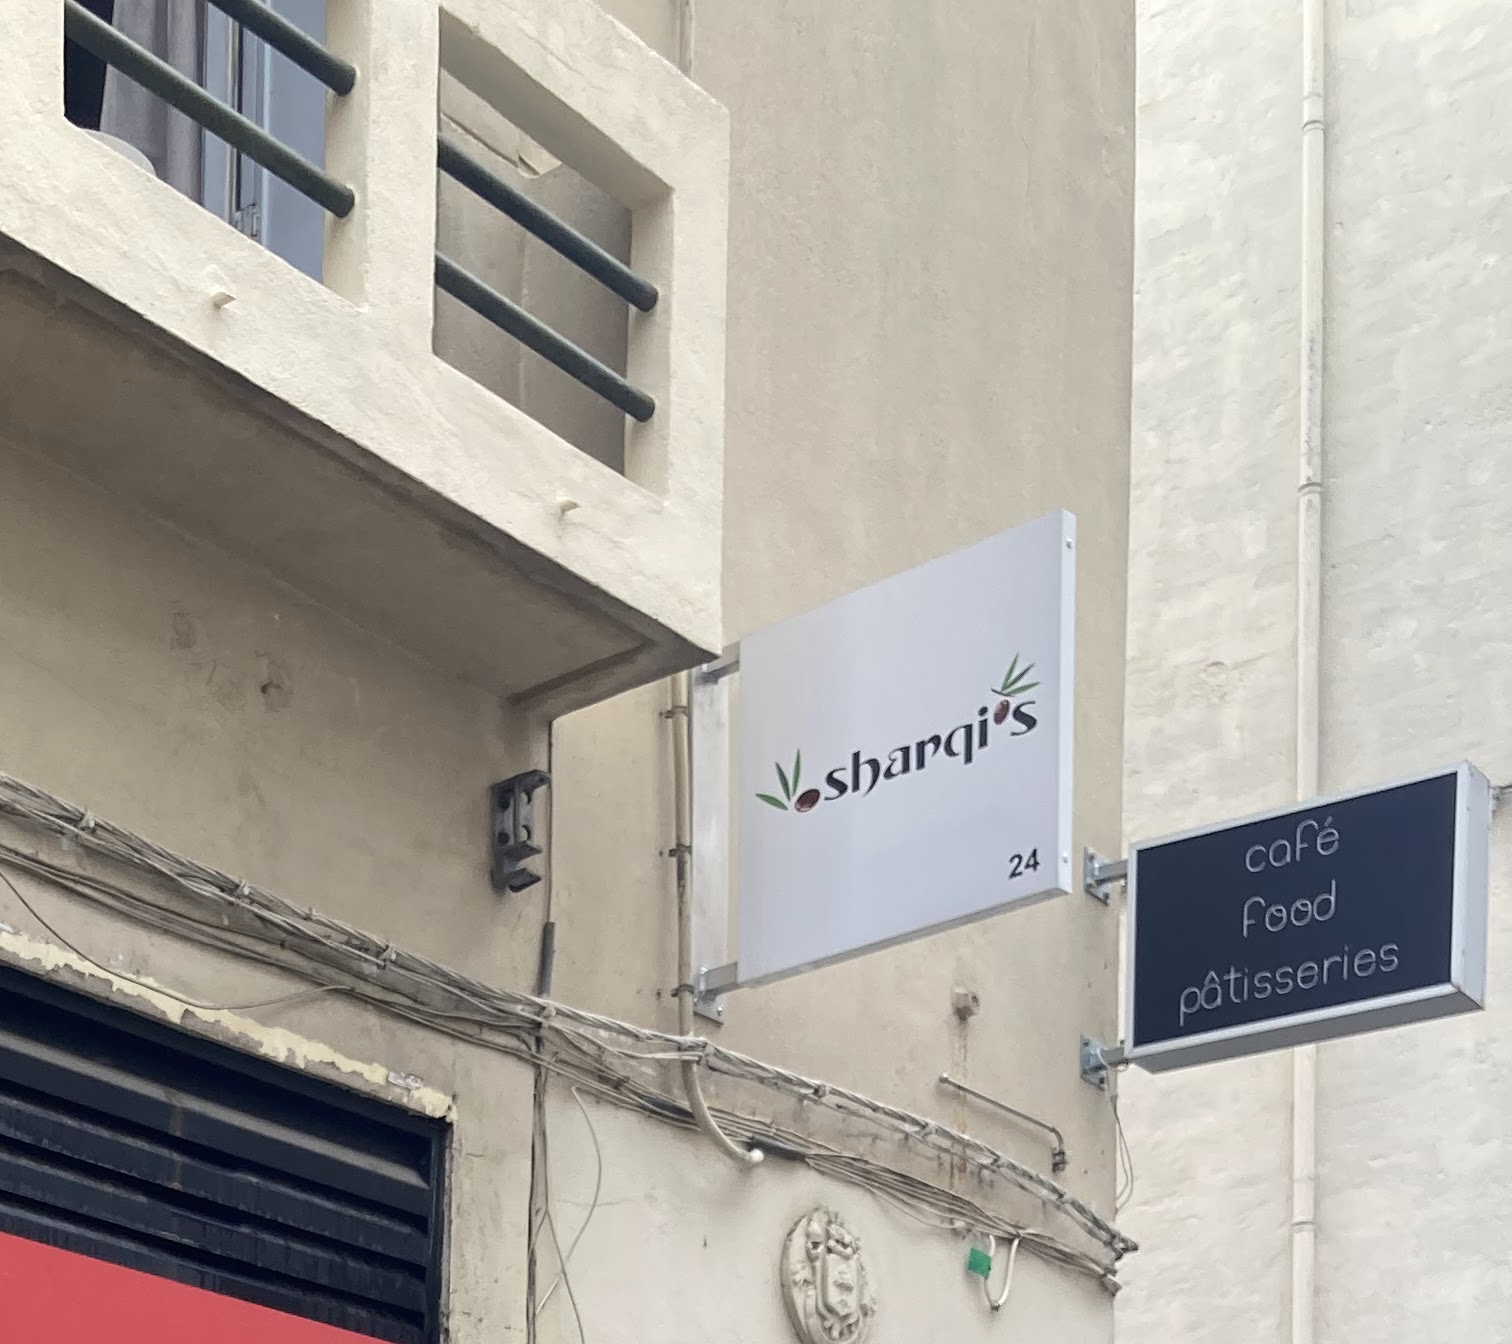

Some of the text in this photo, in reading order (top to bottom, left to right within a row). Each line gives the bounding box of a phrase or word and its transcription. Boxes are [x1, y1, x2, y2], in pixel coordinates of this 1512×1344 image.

[824, 699, 1038, 801] sharqi's
[1007, 848, 1041, 881] 24
[1245, 815, 1340, 872] café
[1242, 879, 1336, 938] food
[1179, 942, 1399, 1027] pâtisseries
